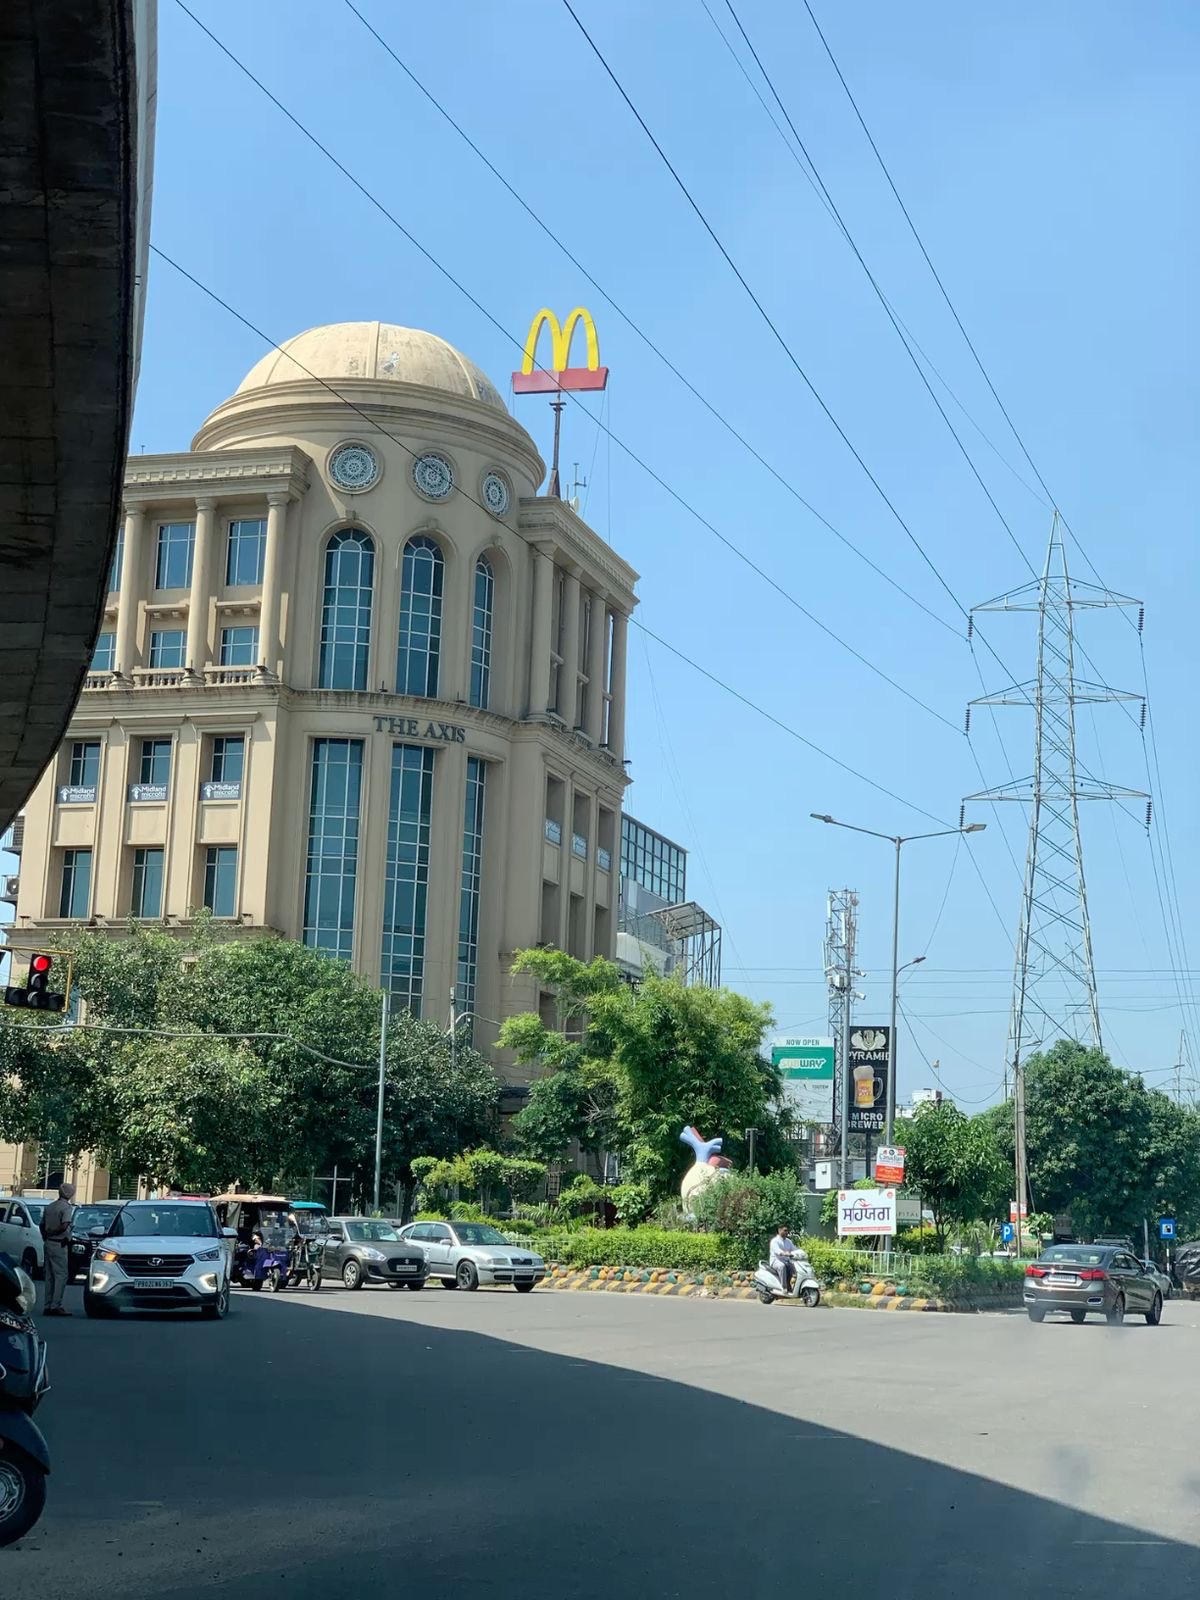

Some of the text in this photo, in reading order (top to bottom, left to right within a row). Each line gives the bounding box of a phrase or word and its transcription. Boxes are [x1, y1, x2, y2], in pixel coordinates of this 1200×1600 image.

[373, 716, 466, 744] THE AXIS
[852, 1112, 883, 1120] MICRO
[1003, 1226, 1011, 1240] P
